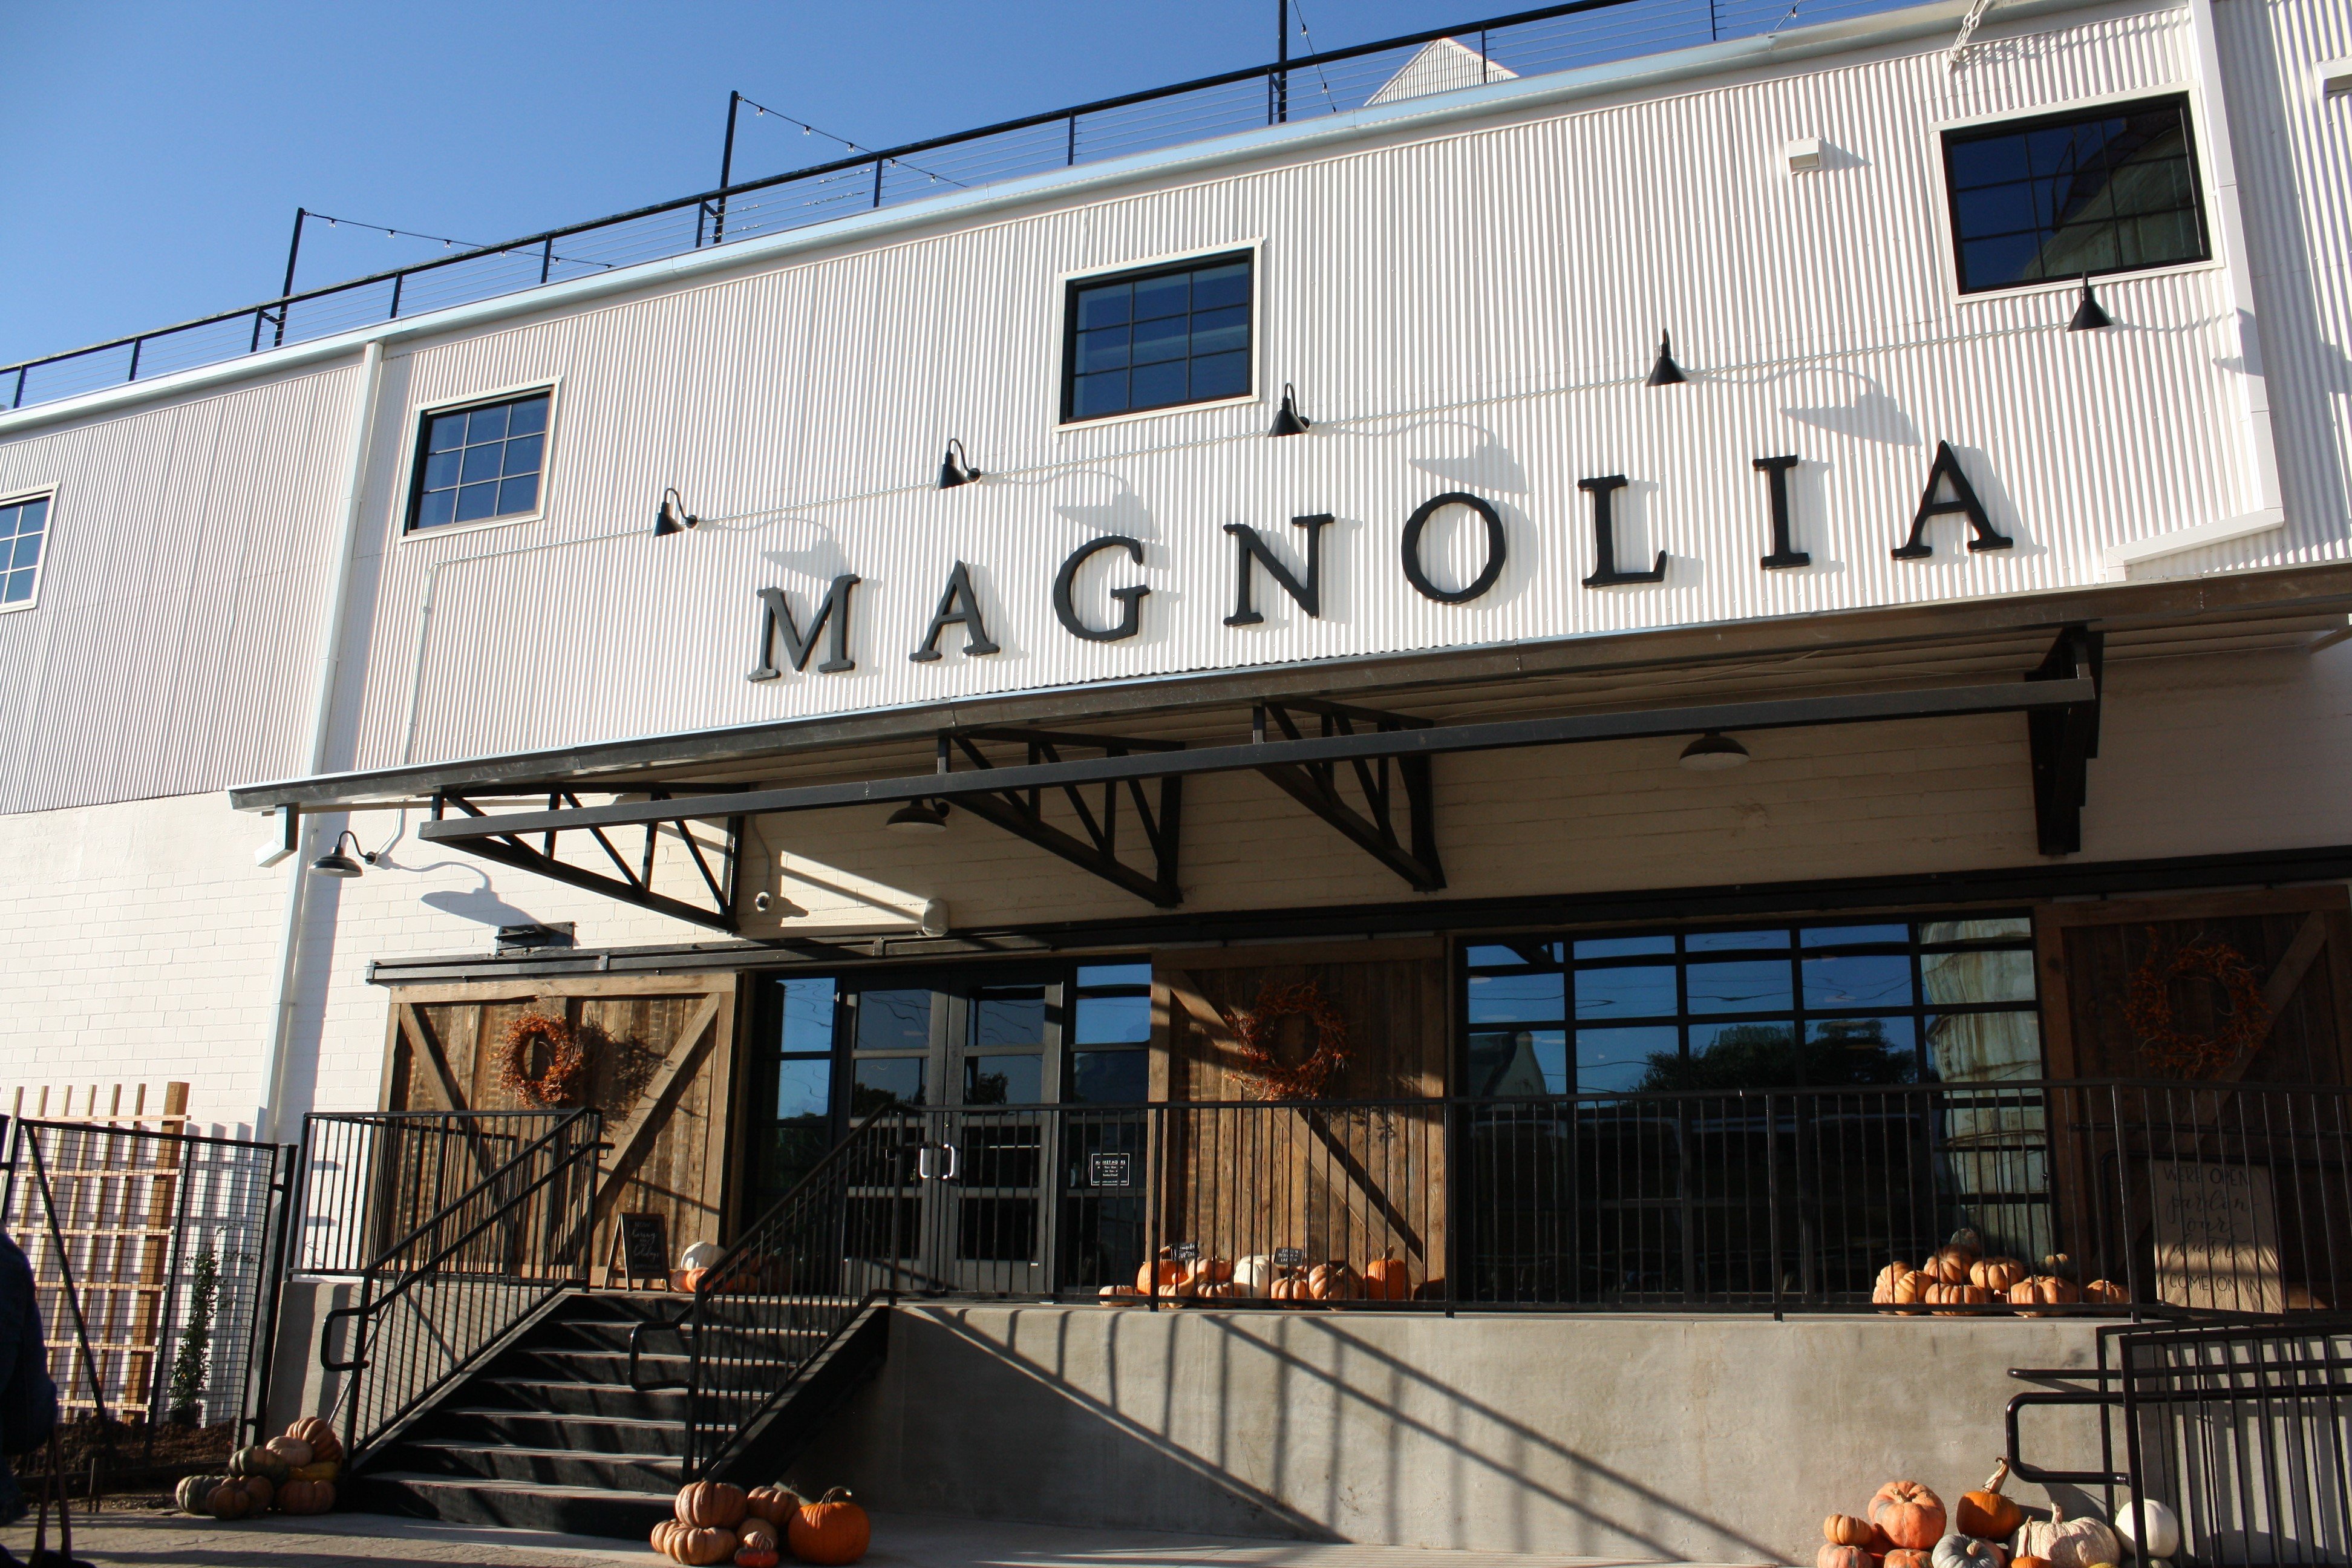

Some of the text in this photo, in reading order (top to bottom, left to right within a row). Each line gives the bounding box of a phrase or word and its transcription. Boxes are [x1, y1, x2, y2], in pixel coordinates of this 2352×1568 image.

[748, 439, 2013, 682] MAGNOLIA
[2209, 1168, 2251, 1186] OPEN
[2187, 1216, 2241, 1233] our
[2172, 1233, 2250, 1259] dust
[2170, 1273, 2261, 1294] COME ON IN
